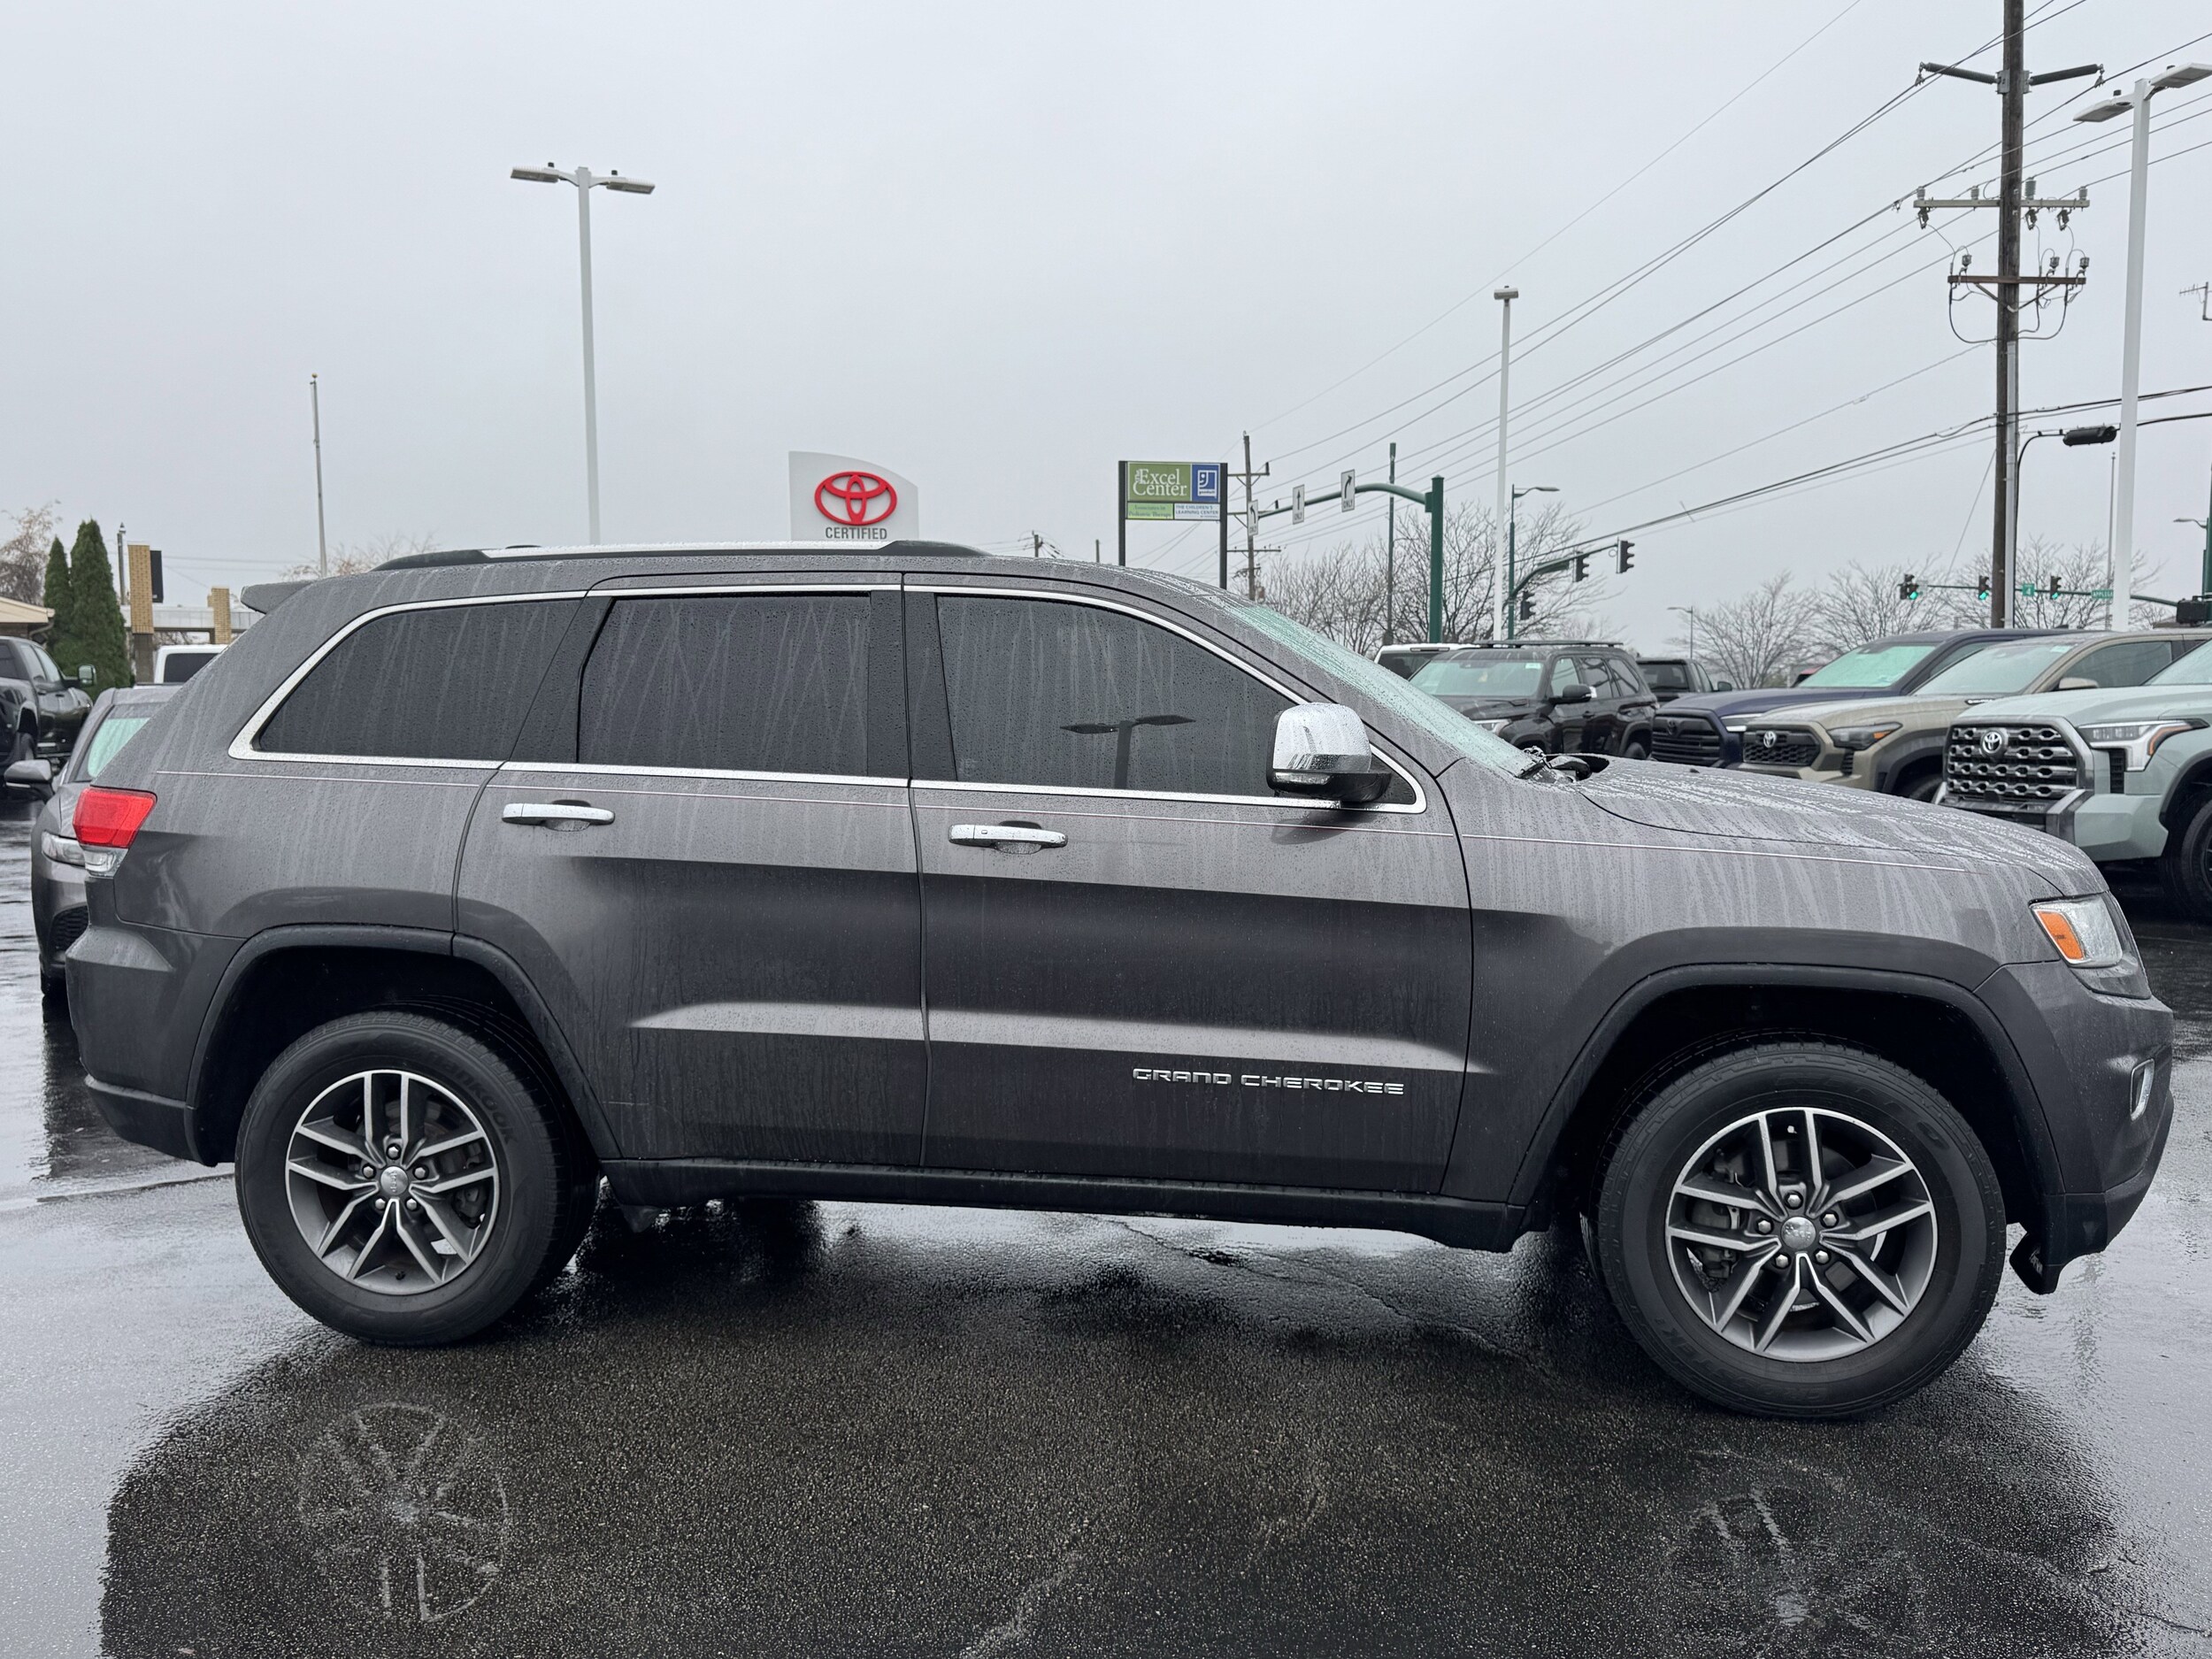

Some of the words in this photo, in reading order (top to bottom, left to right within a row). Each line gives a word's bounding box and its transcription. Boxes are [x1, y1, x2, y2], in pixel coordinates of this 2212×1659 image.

[1140, 468, 1180, 485] Excel
[1133, 481, 1187, 496] Center
[826, 526, 887, 540] CERTIFIED
[1133, 1068, 1232, 1085] GRAND
[1240, 1074, 1404, 1095] CHEROKEE
